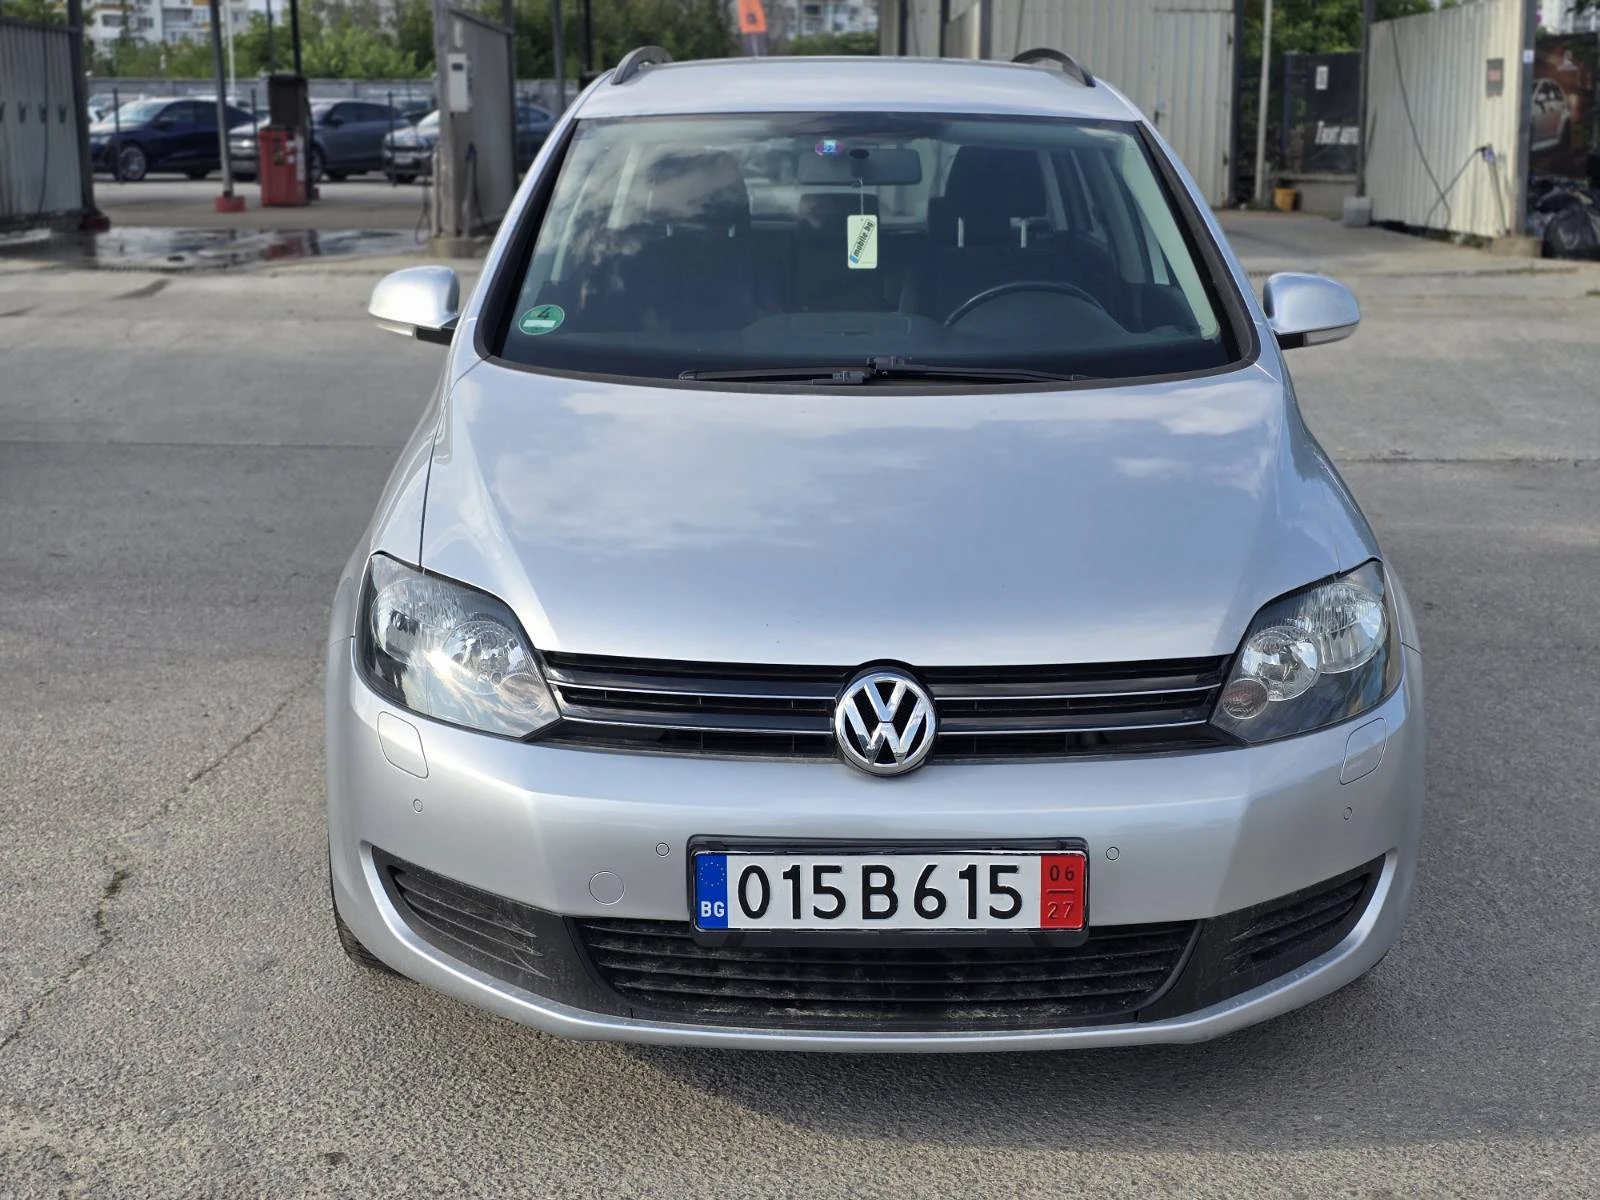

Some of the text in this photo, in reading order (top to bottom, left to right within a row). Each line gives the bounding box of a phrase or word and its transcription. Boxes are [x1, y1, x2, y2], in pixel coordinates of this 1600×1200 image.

[537, 306, 553, 319] 4
[1049, 864, 1075, 881] 06
[700, 901, 725, 918] BG
[1046, 901, 1074, 920] 27
